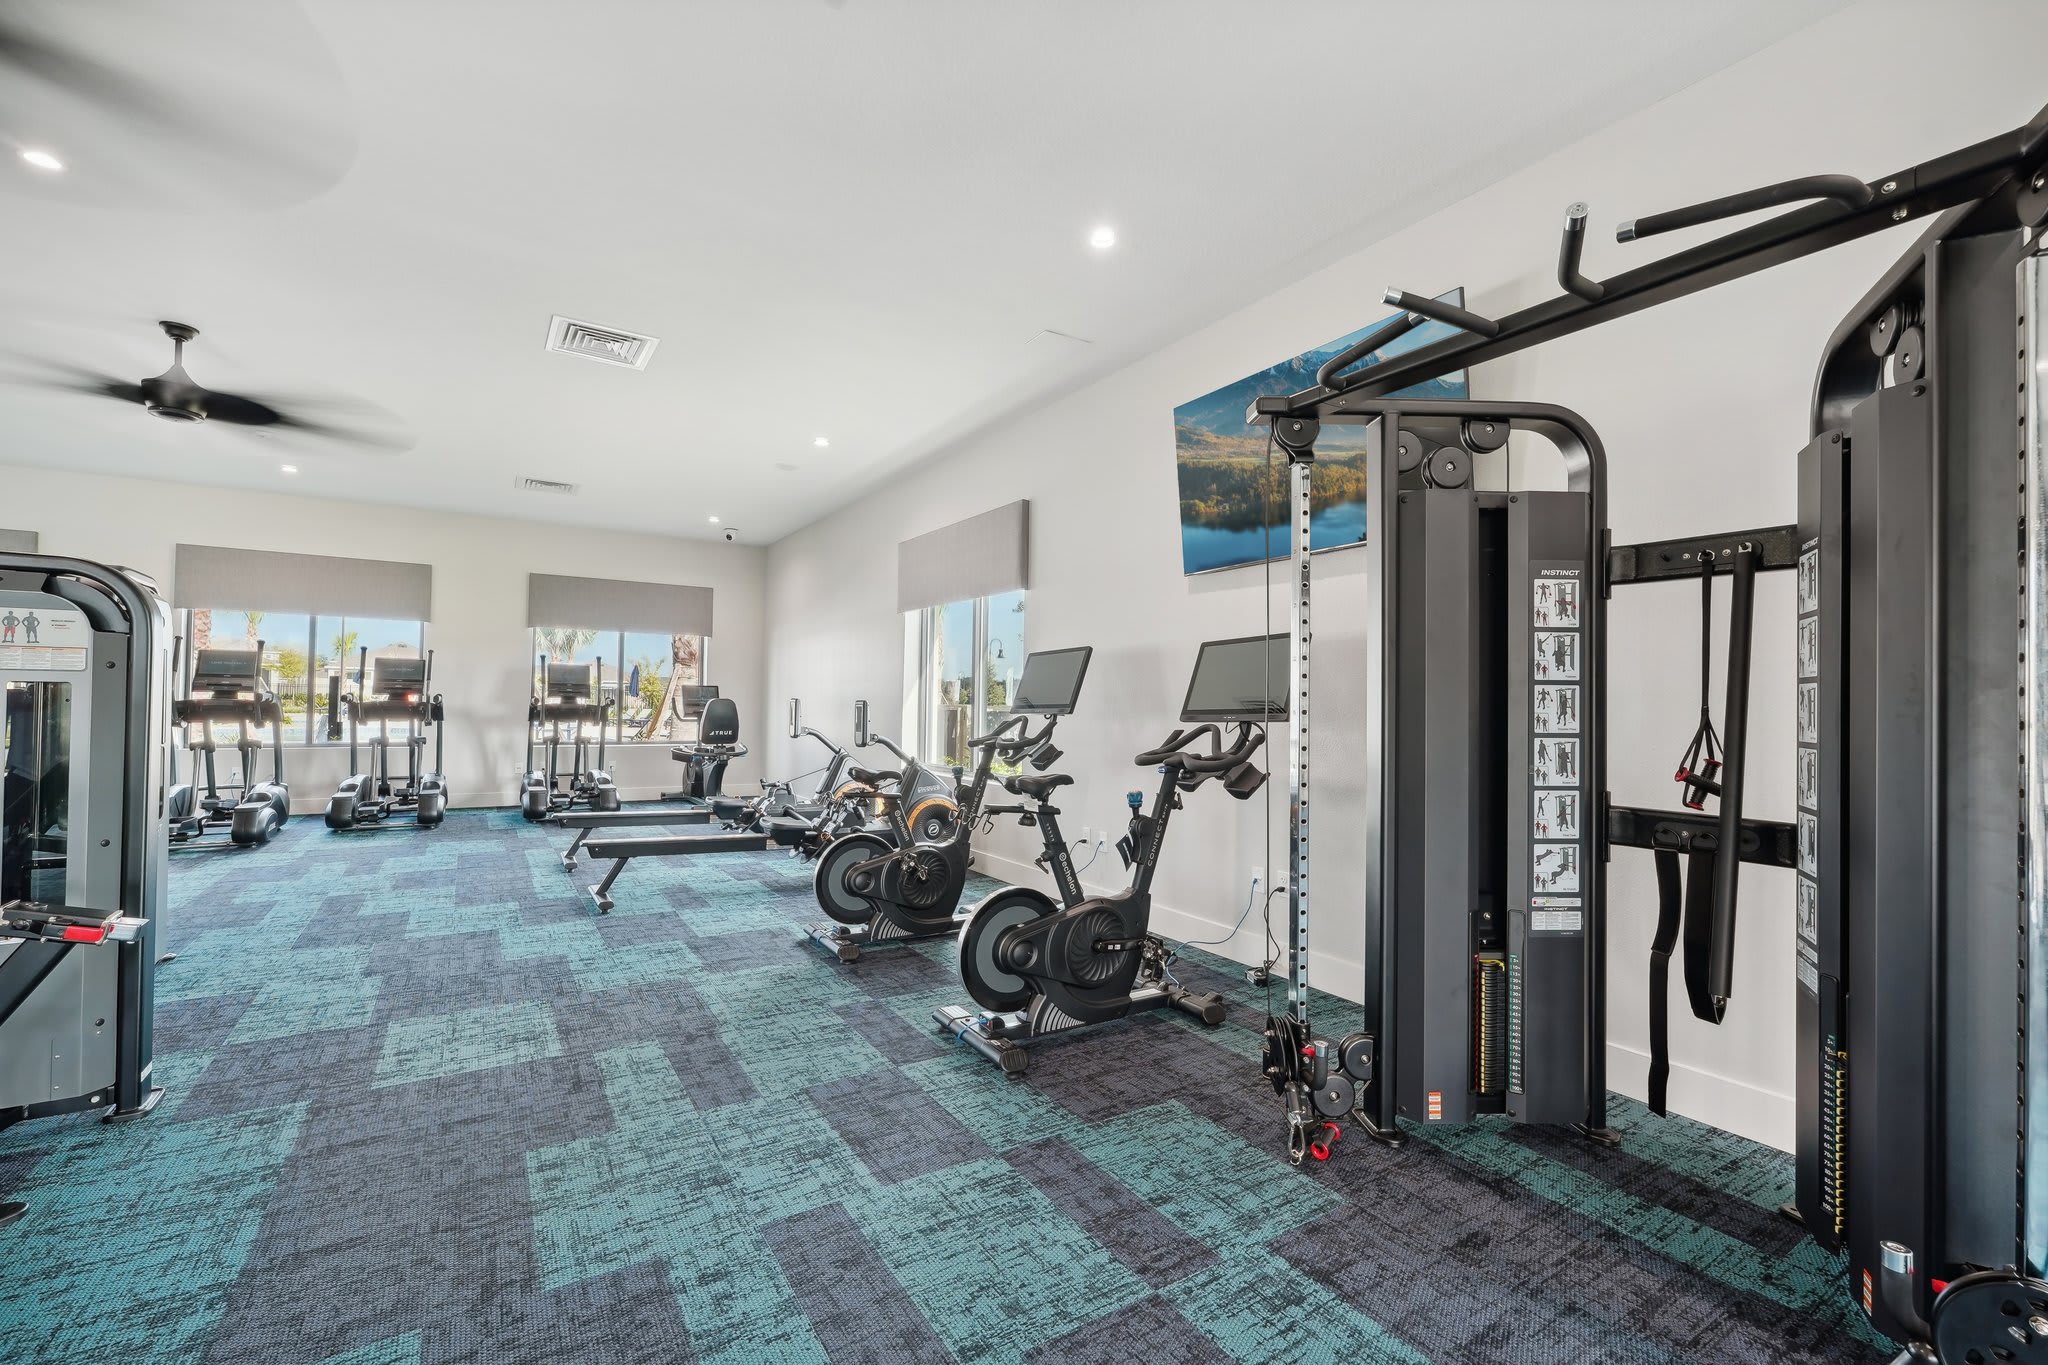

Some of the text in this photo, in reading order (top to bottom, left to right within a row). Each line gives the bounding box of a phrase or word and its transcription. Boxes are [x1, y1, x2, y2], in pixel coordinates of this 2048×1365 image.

[896, 816, 910, 842] echelon
[1147, 818, 1164, 867] CONNECT
[1061, 860, 1078, 896] echelon
